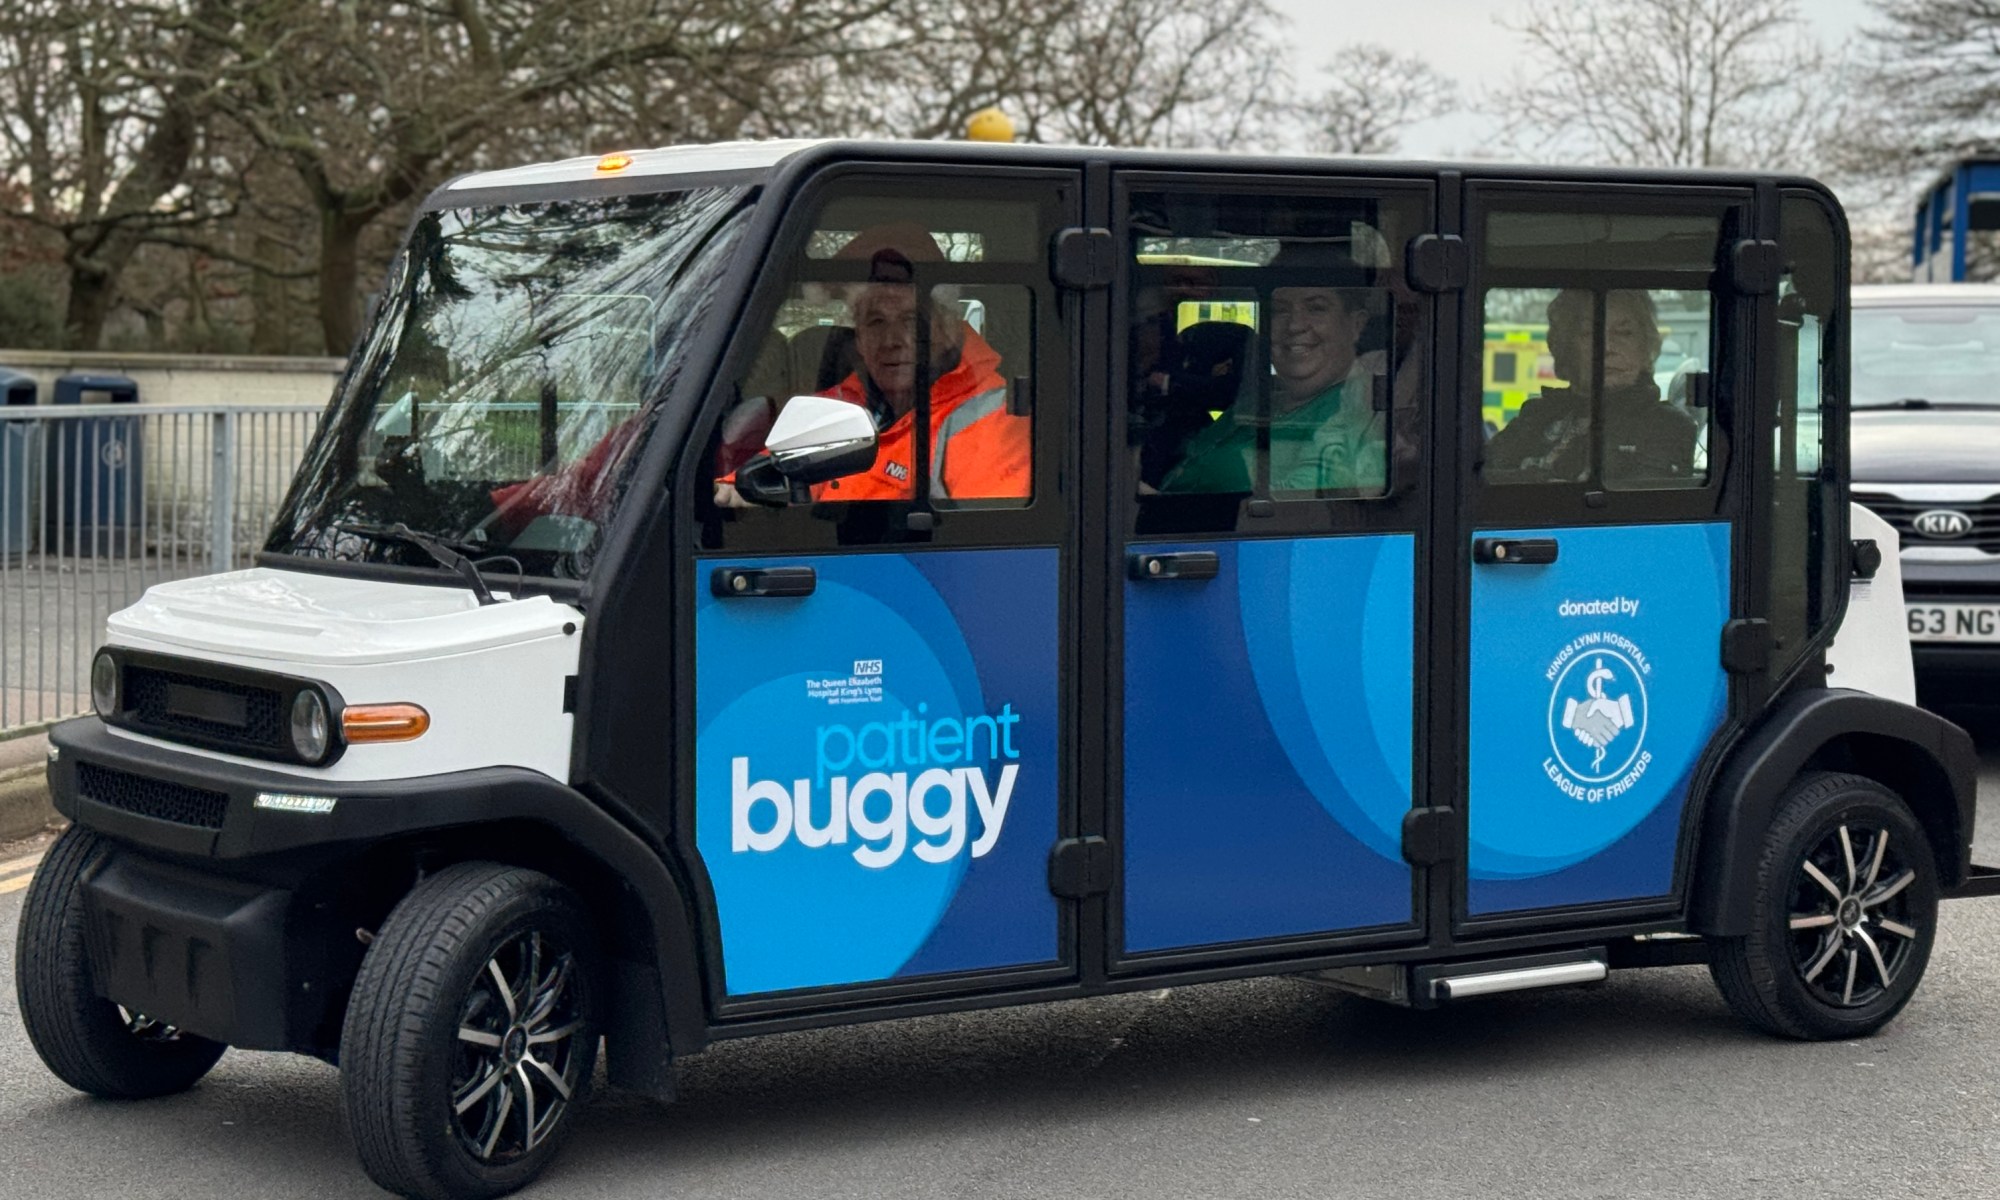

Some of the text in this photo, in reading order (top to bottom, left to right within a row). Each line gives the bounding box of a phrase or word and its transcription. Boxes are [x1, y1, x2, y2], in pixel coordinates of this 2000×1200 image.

[1923, 515, 1962, 532] KIA
[1558, 596, 1639, 618] donated by
[1956, 609, 2000, 635] NG
[855, 661, 881, 674] NHS
[1545, 632, 1651, 681] KINGS LYNN HOSPITALS
[806, 676, 882, 689] The Queen Elizabeth
[808, 687, 882, 699] Hospital King's Lynn
[816, 702, 1020, 789] patient
[1542, 750, 1652, 803] LEAGUE OF FRIENDS
[731, 756, 1020, 869] buggy
